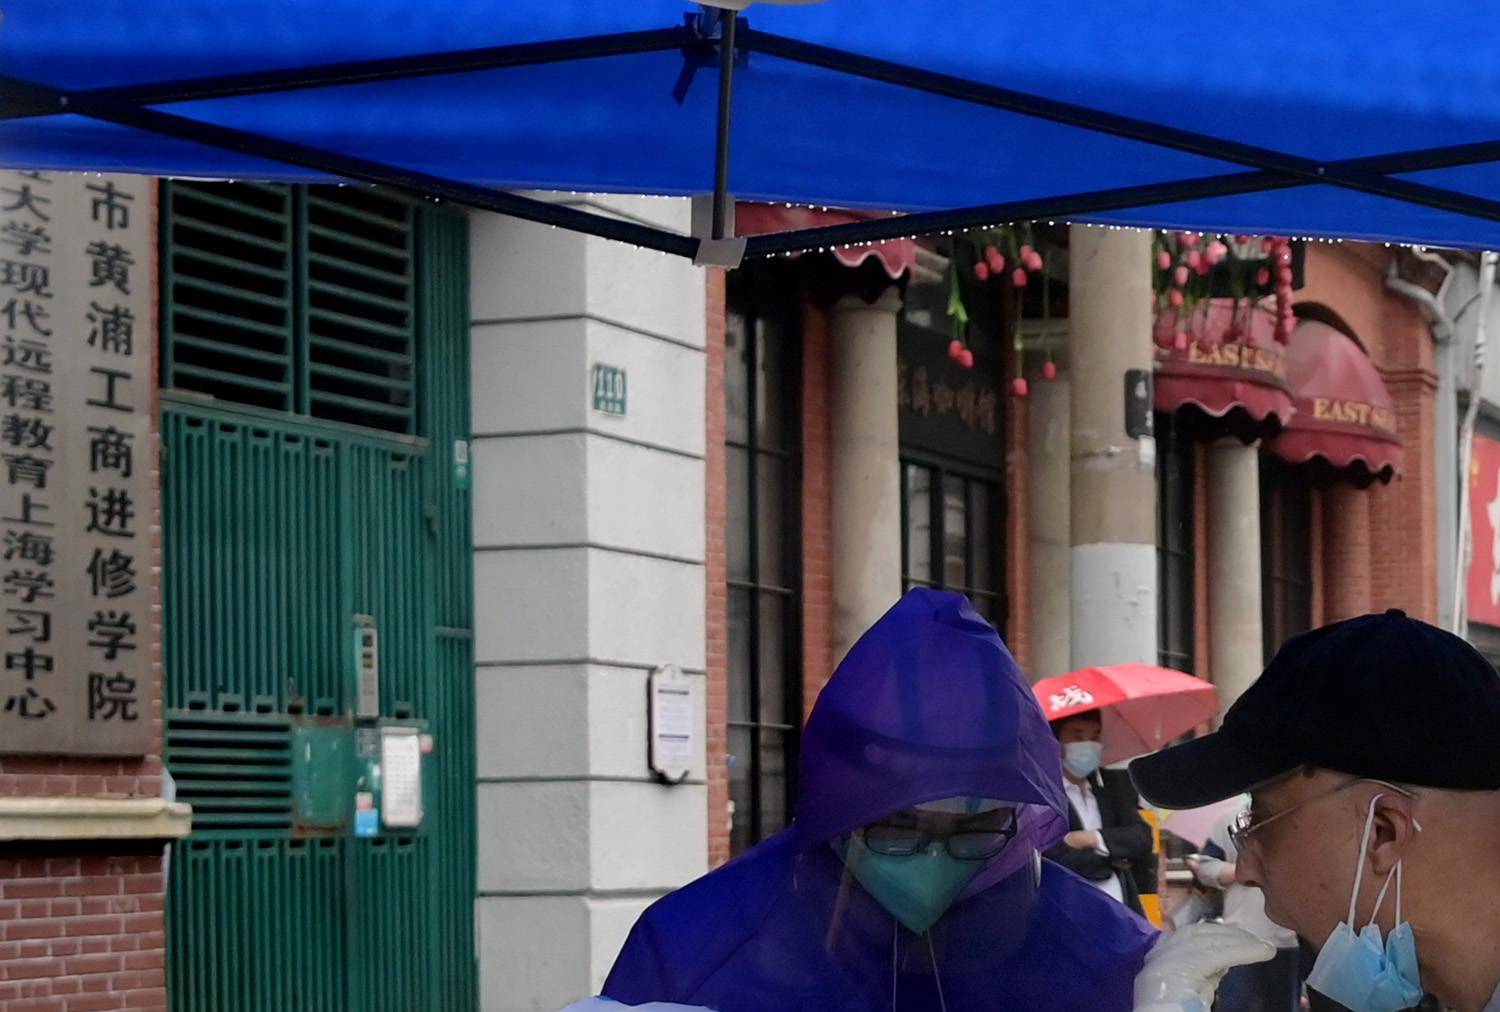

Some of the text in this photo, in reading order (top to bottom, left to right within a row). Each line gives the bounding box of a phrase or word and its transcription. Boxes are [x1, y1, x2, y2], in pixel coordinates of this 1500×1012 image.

[86, 182, 138, 721] 市黄浦工商进修学院
[1312, 397, 1371, 425] EAST
